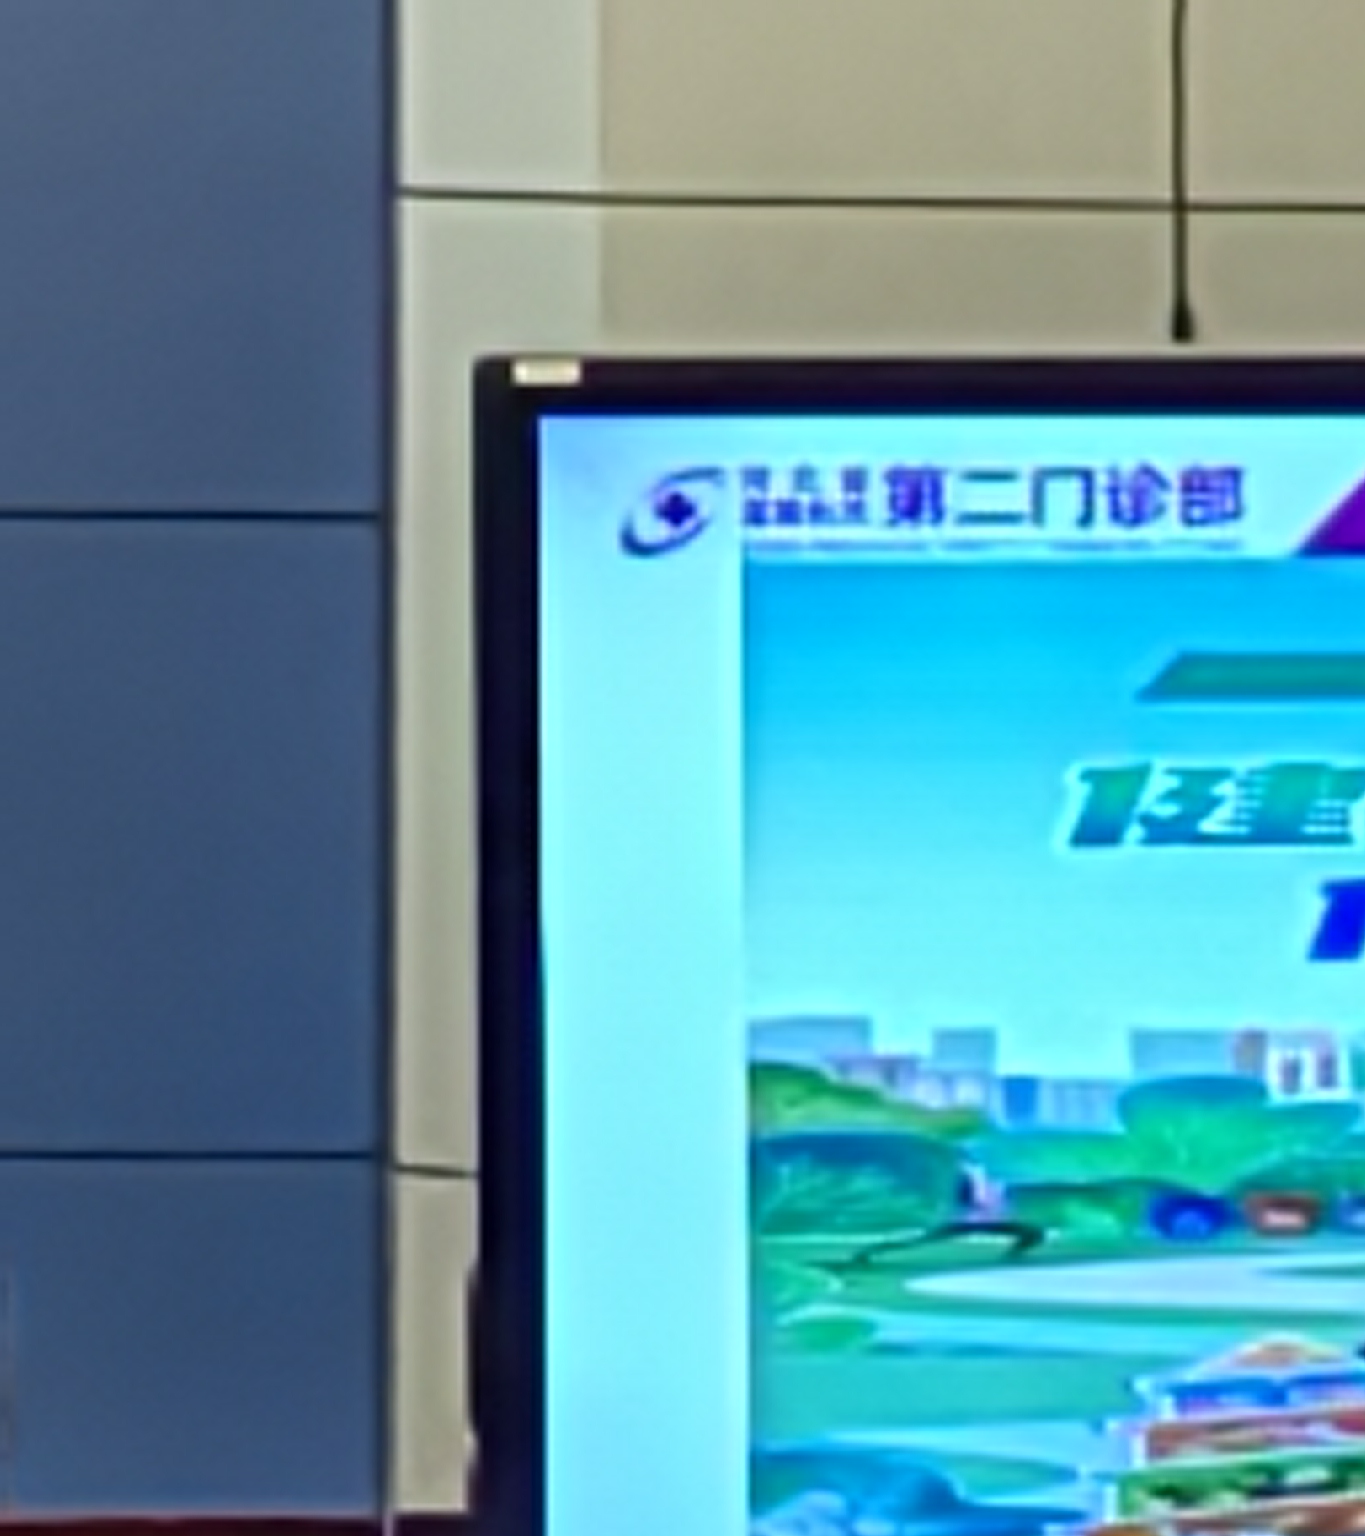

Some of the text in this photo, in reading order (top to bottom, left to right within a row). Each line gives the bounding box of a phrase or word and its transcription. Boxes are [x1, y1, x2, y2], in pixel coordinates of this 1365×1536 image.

[883, 464, 1247, 529] 第二门诊部
